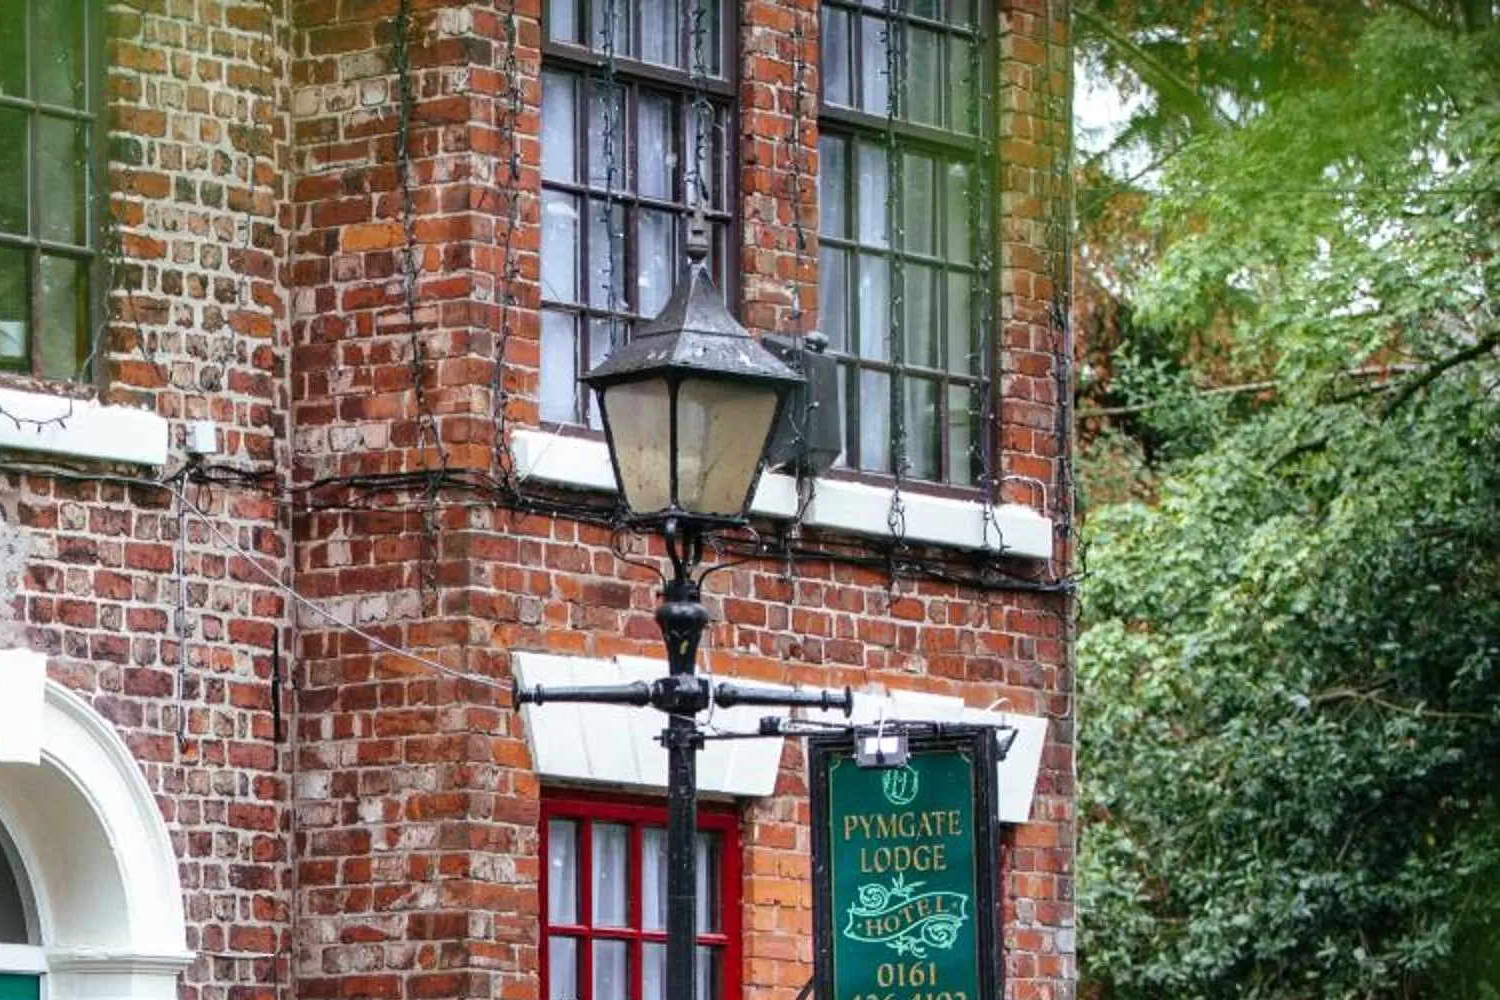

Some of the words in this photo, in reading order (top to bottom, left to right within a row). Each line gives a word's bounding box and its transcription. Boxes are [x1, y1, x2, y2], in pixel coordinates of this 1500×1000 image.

[843, 810, 963, 841] PYMGATE
[860, 844, 948, 873] LODGE
[864, 895, 946, 937] HOTEL
[876, 961, 937, 988] 0161
